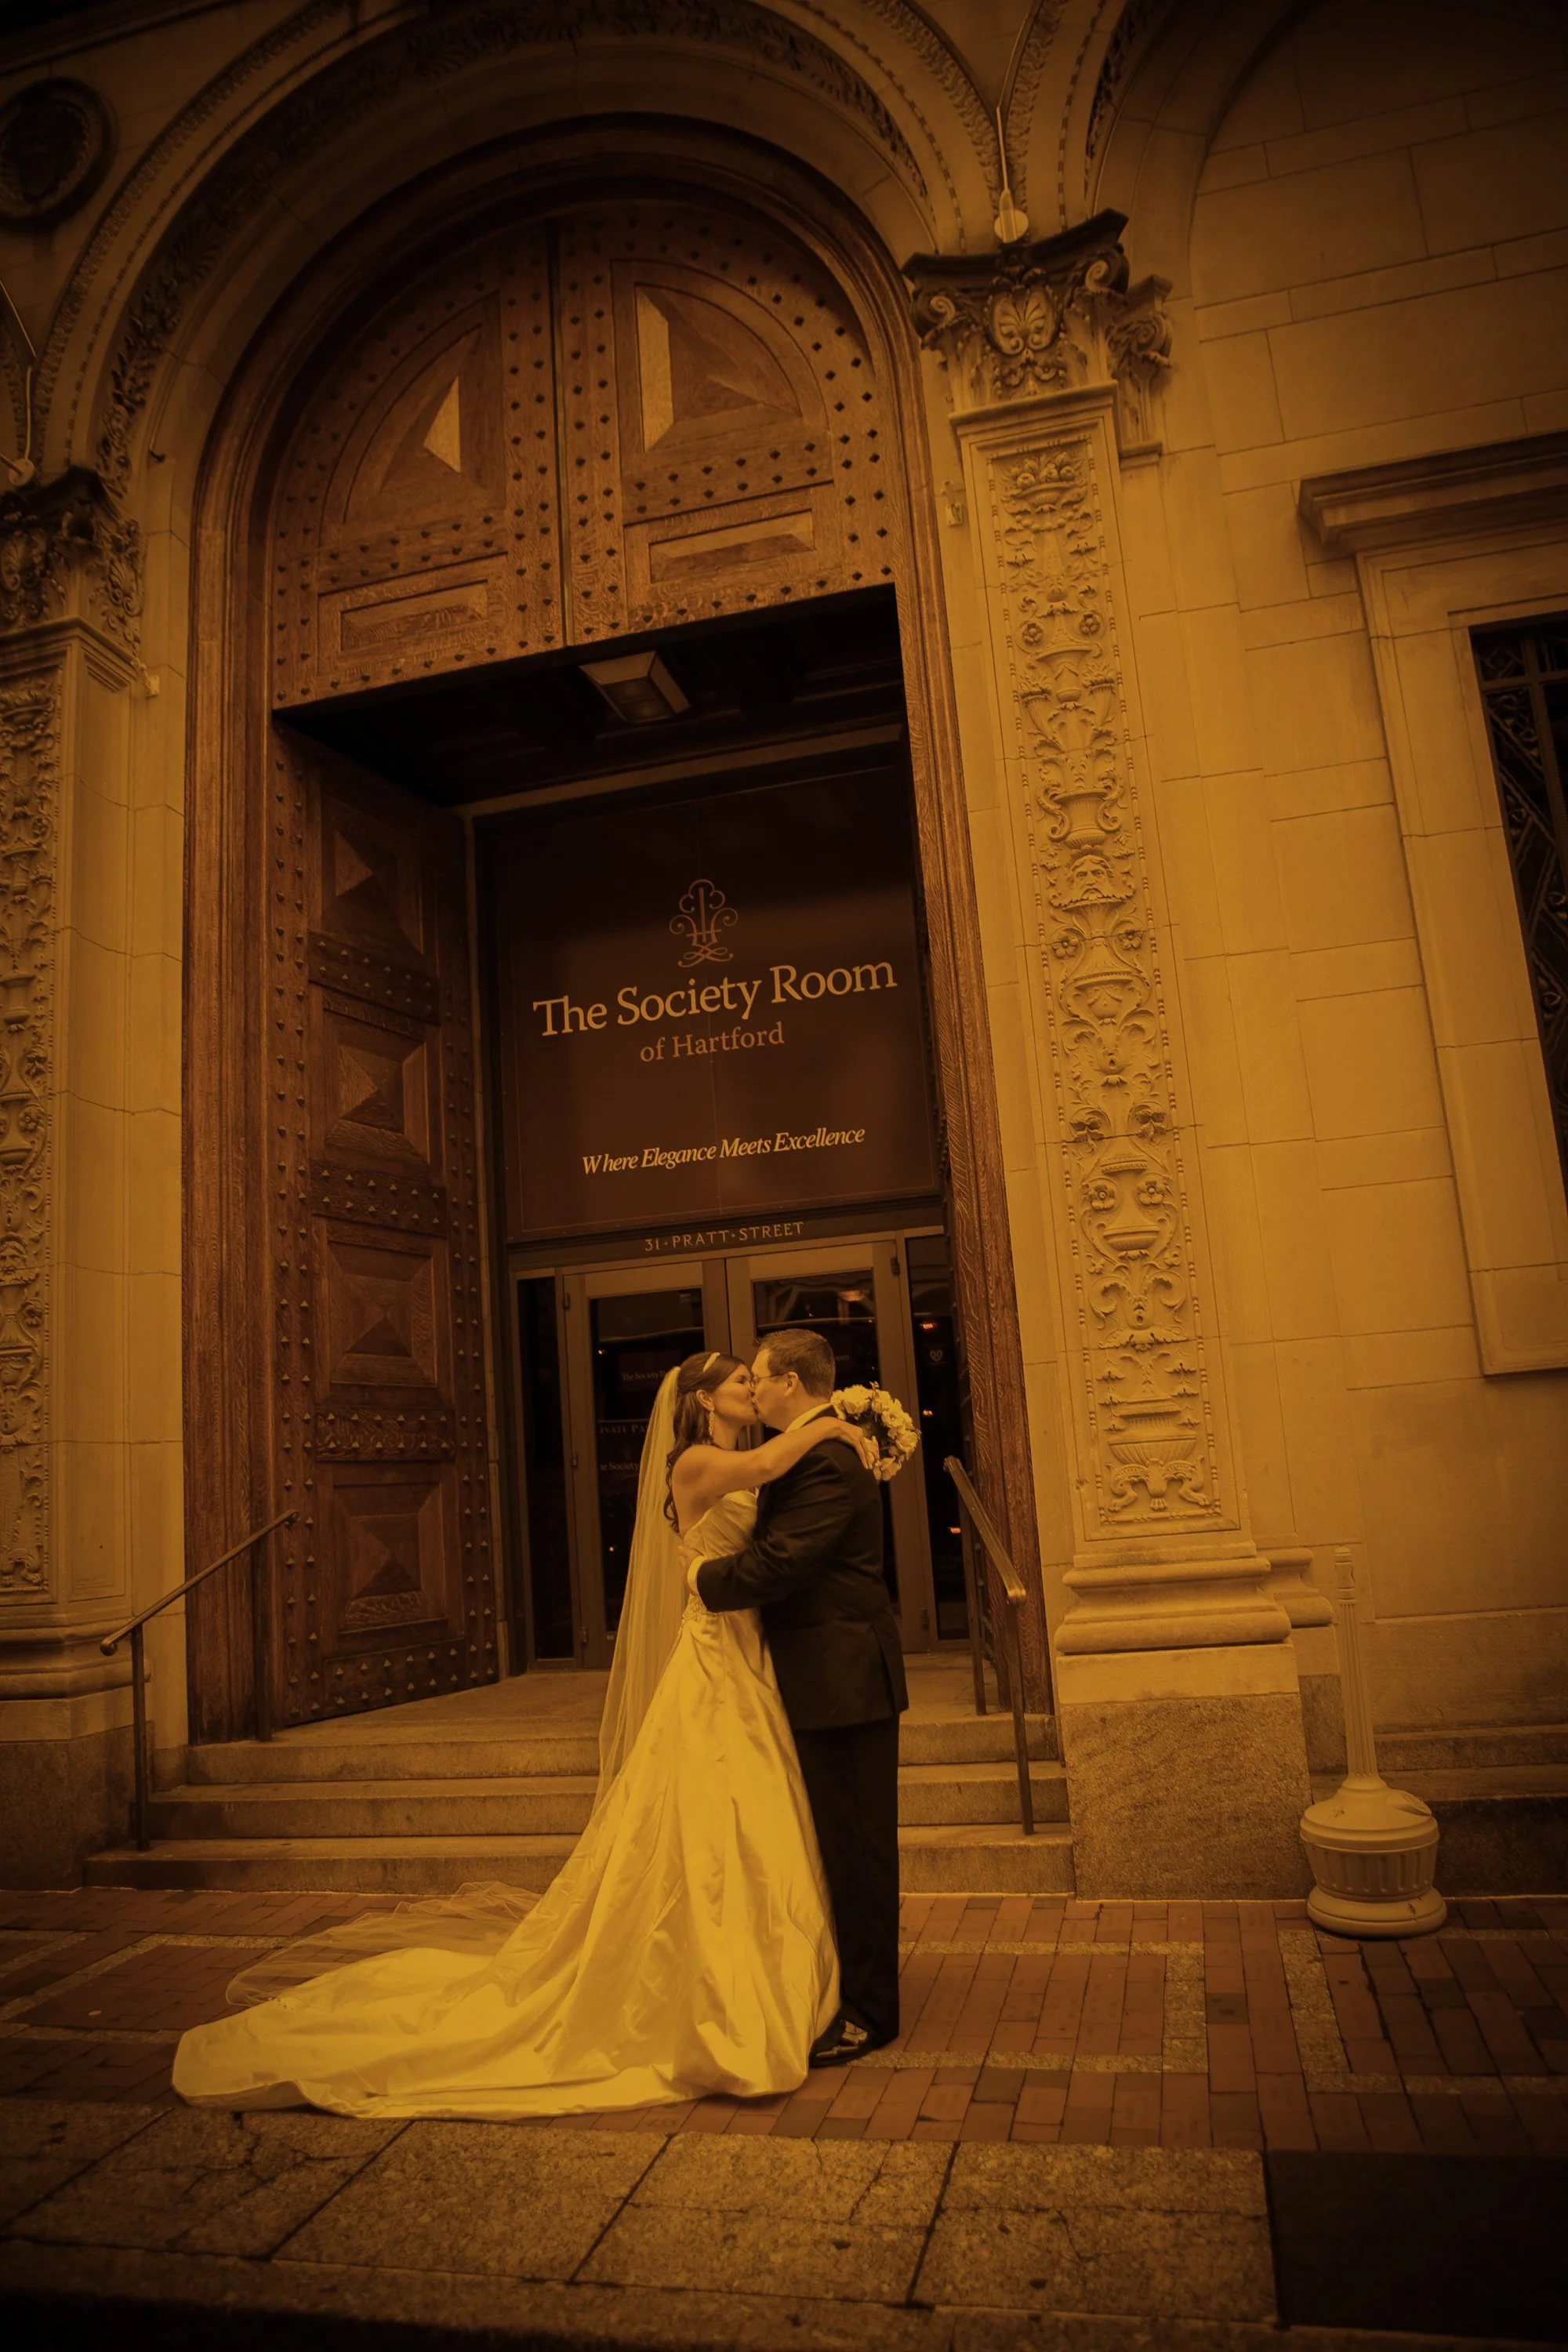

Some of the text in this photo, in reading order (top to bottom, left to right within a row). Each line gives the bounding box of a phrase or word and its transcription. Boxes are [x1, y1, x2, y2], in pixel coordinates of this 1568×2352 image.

[532, 961, 898, 1036] The Society Room
[640, 1021, 785, 1062] of Hartford
[582, 1127, 866, 1175] Where Elegance Meets Excellence
[644, 1221, 804, 1251] 31 PRATT STREET
